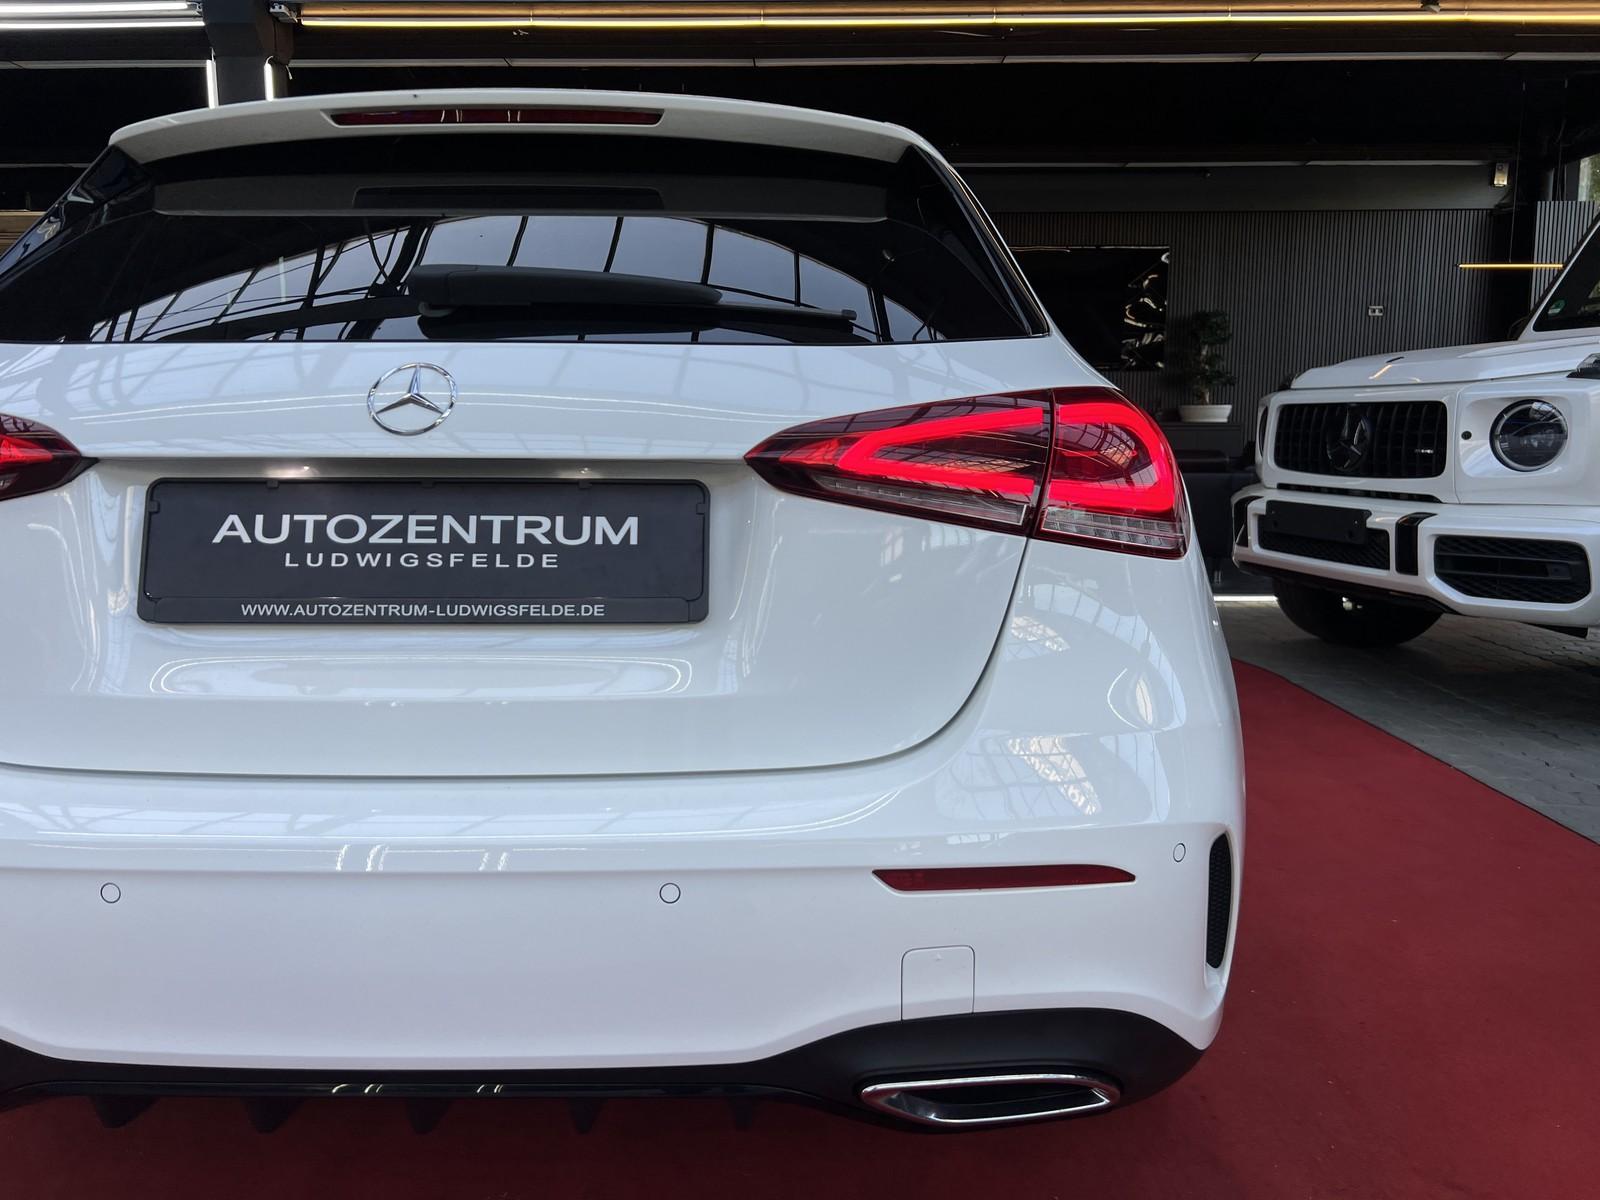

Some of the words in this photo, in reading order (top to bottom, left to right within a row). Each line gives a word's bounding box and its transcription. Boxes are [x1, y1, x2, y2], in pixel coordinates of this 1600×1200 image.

[212, 513, 639, 546] AUTOZENTRUM
[284, 552, 558, 568] LUDWIGSFELDE
[240, 604, 605, 617] WWW.AUTOZENTRUM-LUDWIGSFELDE.DE
